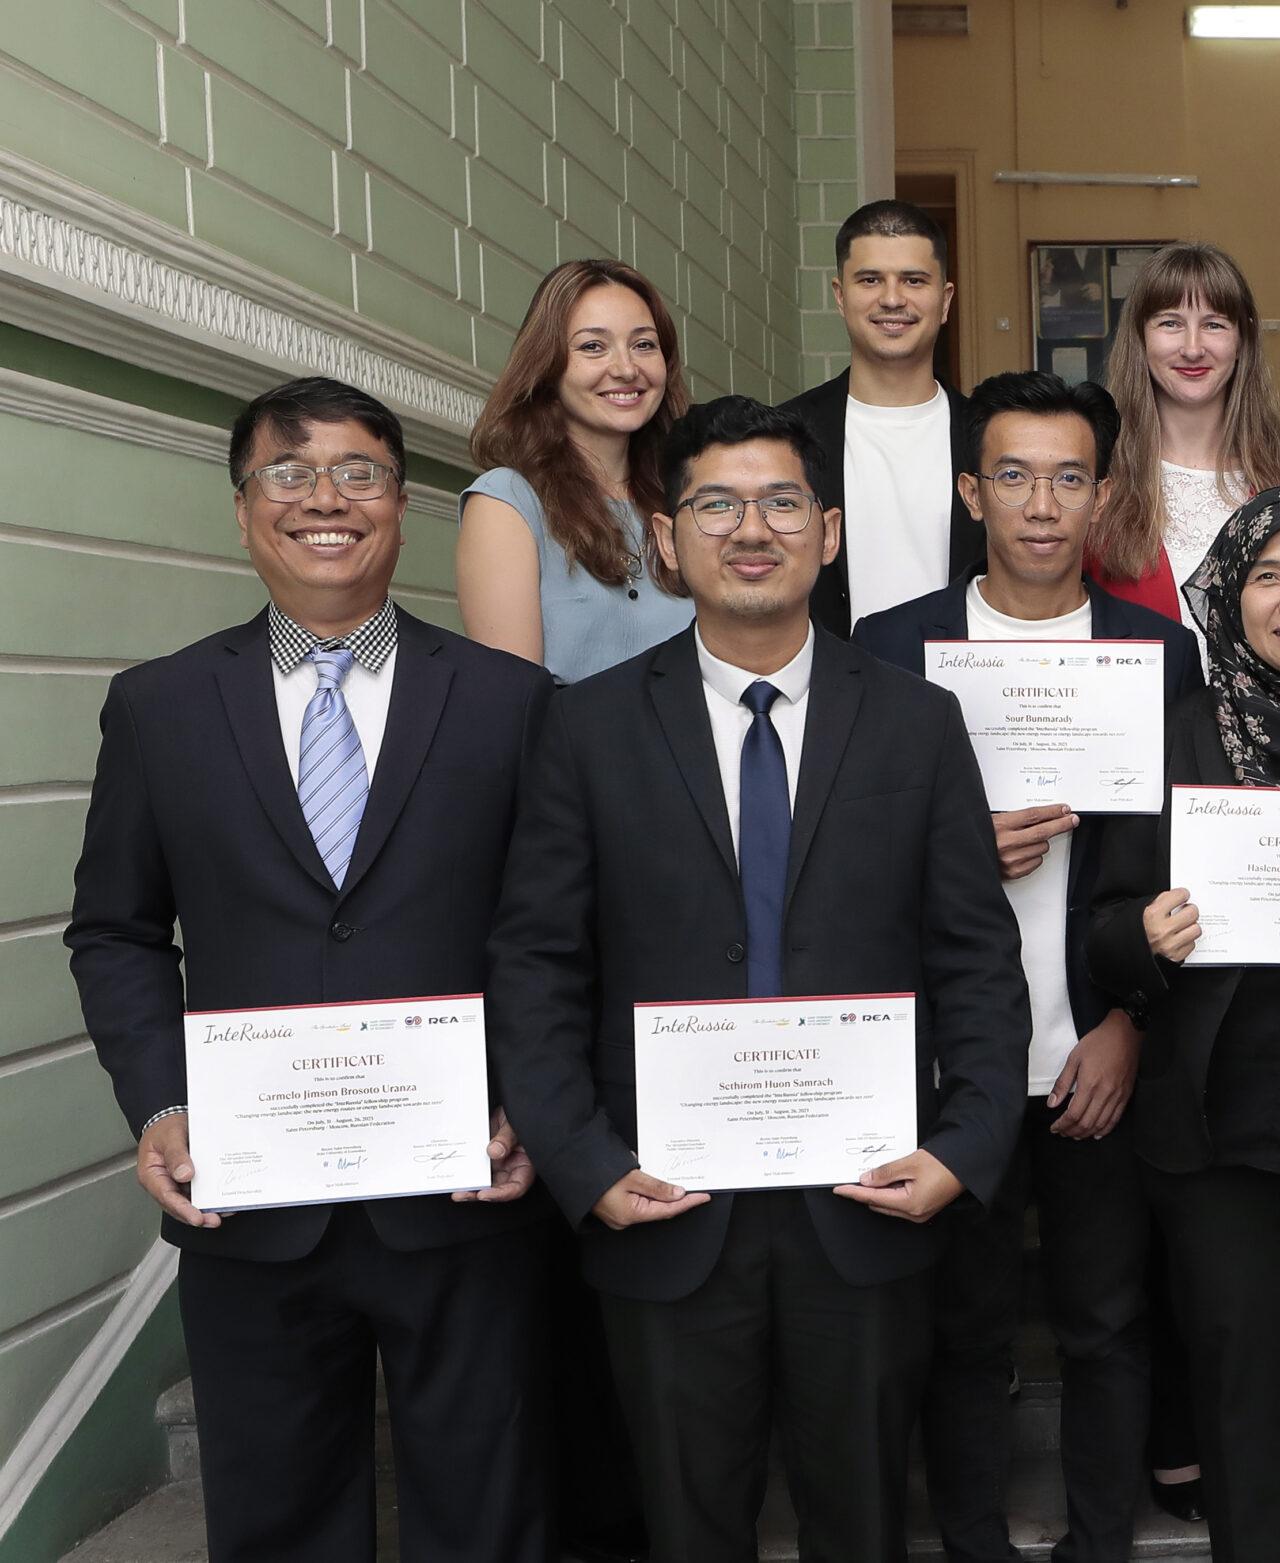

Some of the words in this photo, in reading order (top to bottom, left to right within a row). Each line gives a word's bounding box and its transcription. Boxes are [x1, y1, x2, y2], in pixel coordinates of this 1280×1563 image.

[937, 652, 1005, 669] InteRussia
[1002, 687, 1078, 698] CERTIFICATE
[1005, 714, 1024, 722] Sour
[1026, 715, 1072, 724] Bunmarady
[1186, 797, 1263, 816] InteRussia
[428, 1016, 459, 1025] REA
[651, 1015, 736, 1035] InteRussia
[862, 1014, 891, 1022] REA
[203, 1023, 293, 1044] InteRussia
[292, 1054, 385, 1071] CERTIFICATE
[734, 1049, 820, 1062] CERTIFICATE
[719, 1081, 762, 1091] Sethirom
[765, 1080, 791, 1089] Huon
[793, 1077, 833, 1087] Samrach
[258, 1091, 301, 1102] Carmelo
[303, 1090, 338, 1100] Jimson
[341, 1087, 380, 1096] Brosoto
[382, 1084, 417, 1093] Uranza
